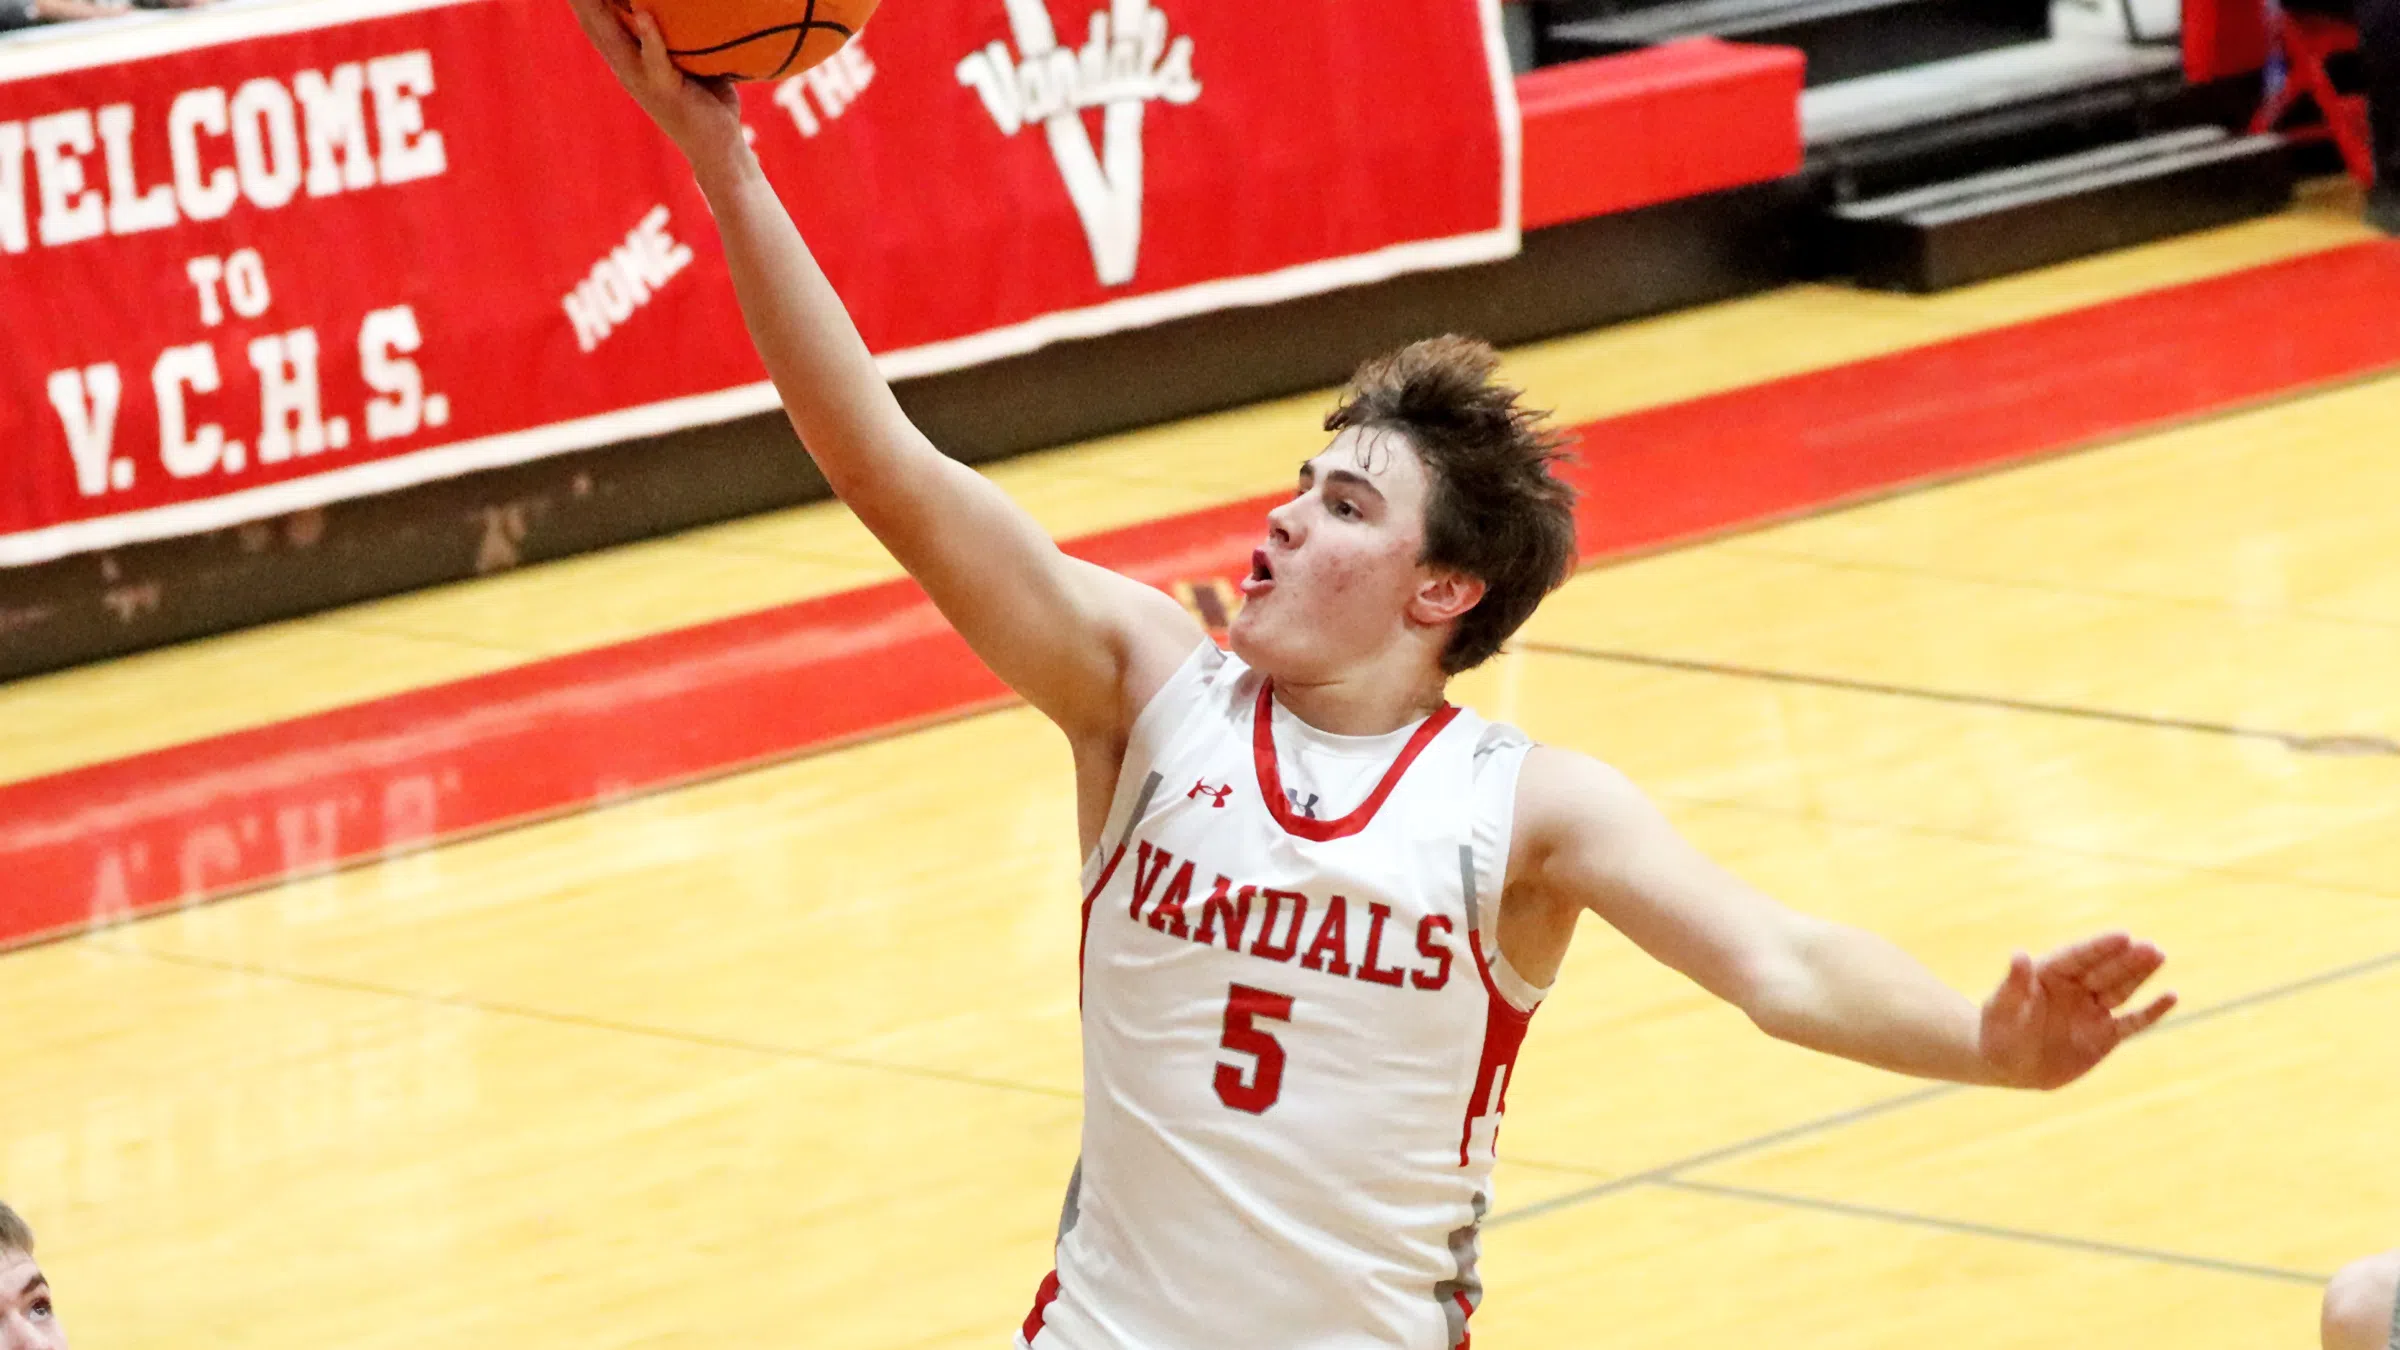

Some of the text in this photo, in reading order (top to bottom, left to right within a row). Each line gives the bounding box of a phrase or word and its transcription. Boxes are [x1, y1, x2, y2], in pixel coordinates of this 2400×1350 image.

[954, 7, 1202, 136] Vandals
[562, 27, 876, 353] HOME THE
[186, 247, 271, 327] TO
[1126, 839, 1454, 992] VANDALS
[1212, 982, 1296, 1116] 5
